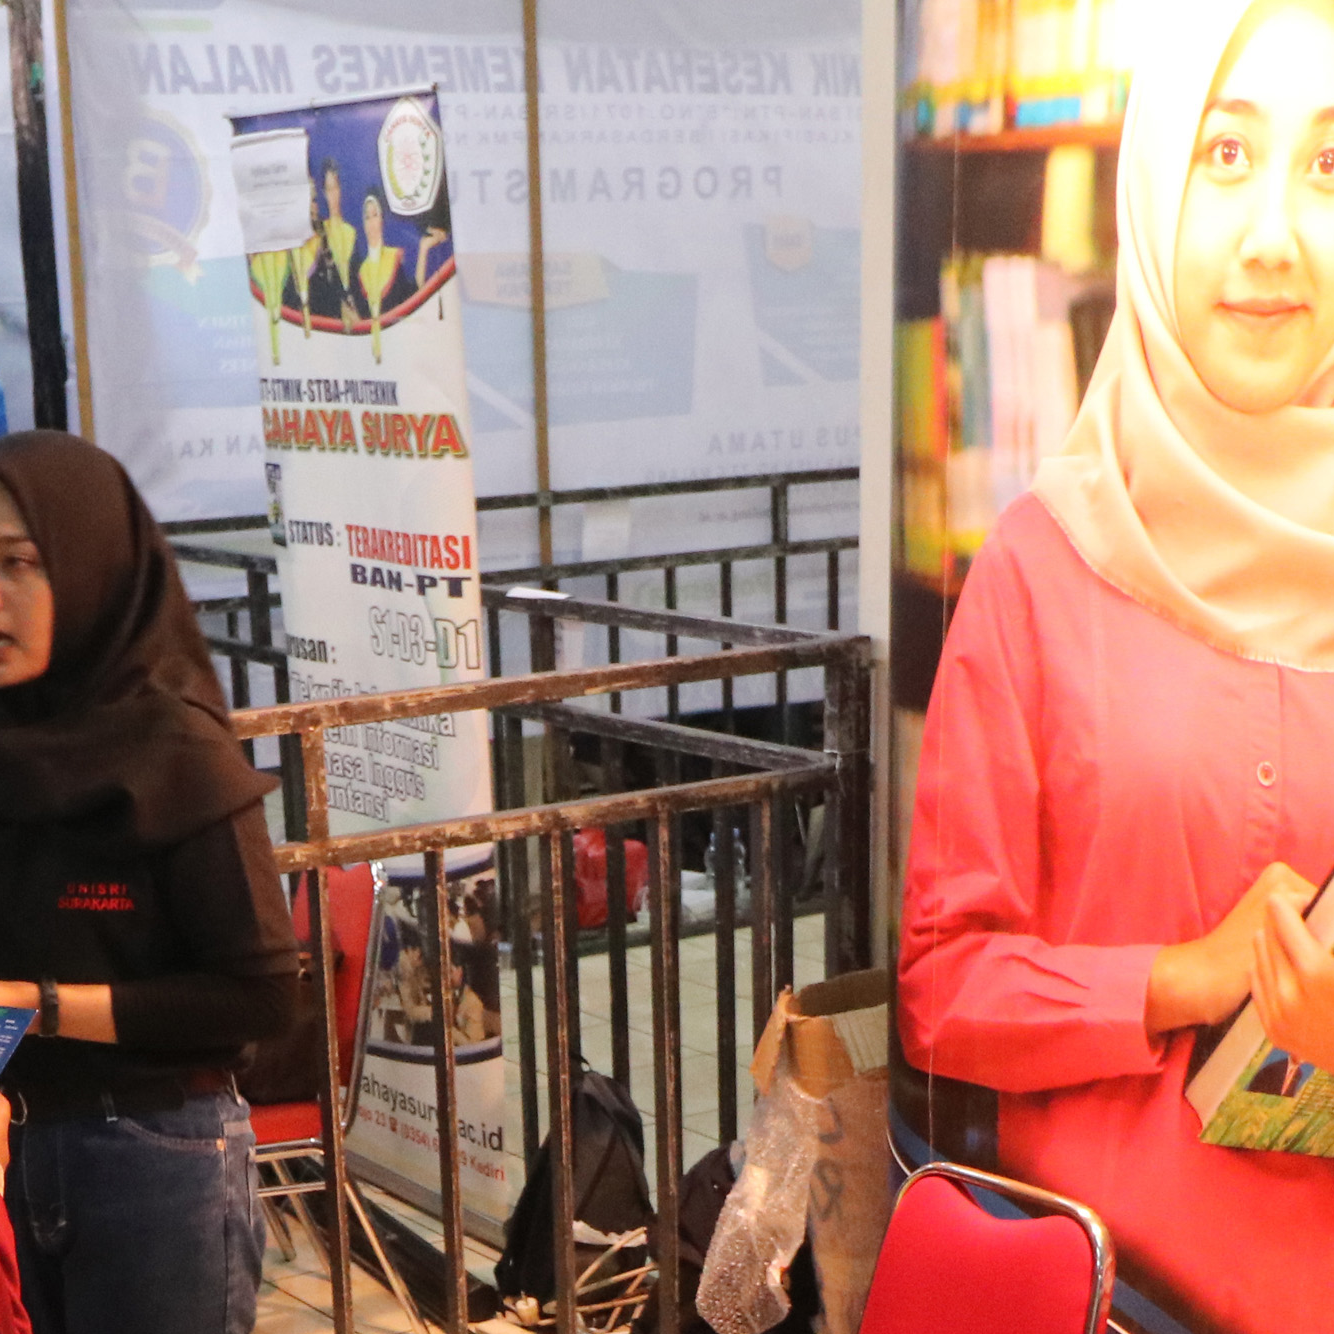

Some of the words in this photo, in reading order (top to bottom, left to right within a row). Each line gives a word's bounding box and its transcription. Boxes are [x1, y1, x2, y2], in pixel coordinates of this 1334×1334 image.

[361, 411, 468, 459] SURYA
[288, 519, 334, 547] STATUS
[345, 523, 472, 570] TERAKREDITASI
[351, 563, 472, 598] BAN-PT
[369, 605, 481, 670] S1-D3-D1
[66, 882, 128, 896] UNISRI
